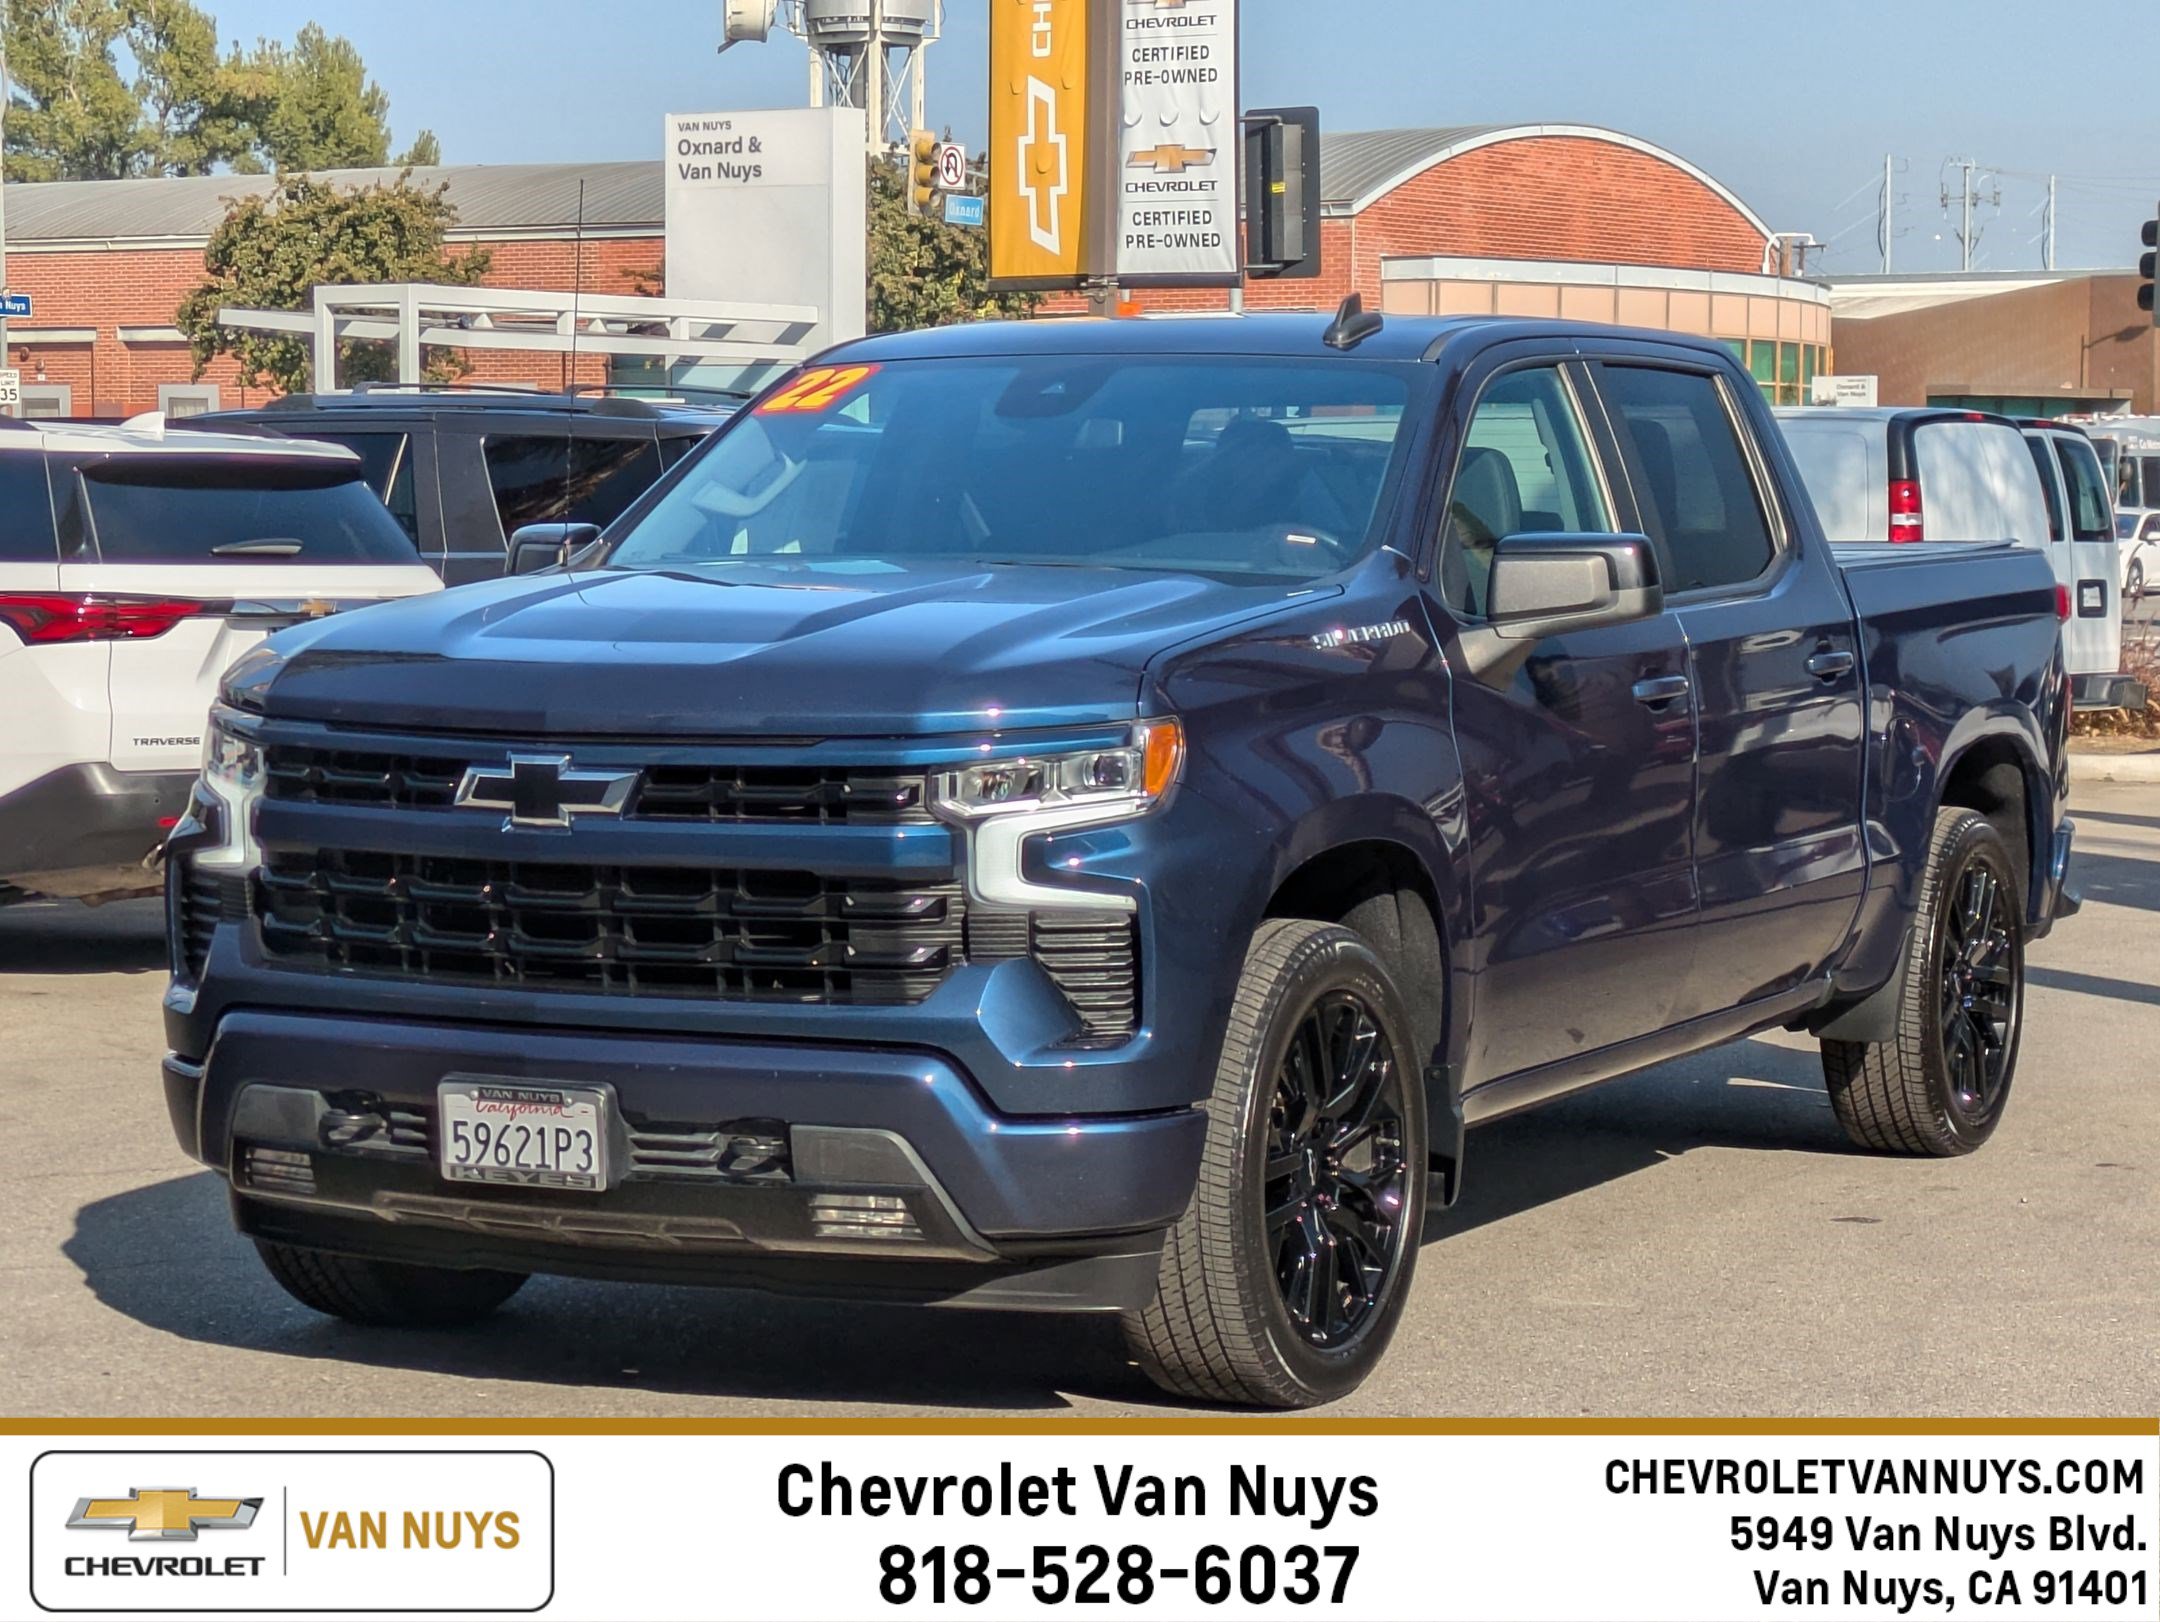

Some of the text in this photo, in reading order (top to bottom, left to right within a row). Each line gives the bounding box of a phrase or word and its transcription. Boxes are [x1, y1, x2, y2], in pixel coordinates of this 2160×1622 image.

[1126, 15, 1217, 30] CHEVROLET
[1132, 45, 1210, 63] CERTIFIED
[1124, 68, 1218, 86] PRE-OWNED
[677, 120, 732, 132] VAN NUYS
[677, 136, 762, 156] Oxnard &
[678, 162, 762, 183] Van Nuys
[1125, 180, 1219, 193] CHEVROLET
[1132, 210, 1212, 226] CERTIFIED
[1125, 233, 1221, 249] PRE-OWNED
[0, 388, 17, 401] 35
[761, 366, 870, 411] 22
[133, 736, 201, 746] TRAVERSE
[481, 1087, 561, 1104] VAN NUYS
[475, 1099, 575, 1121] California
[452, 1119, 593, 1174] 59621P3
[453, 1167, 596, 1189] KEYES
